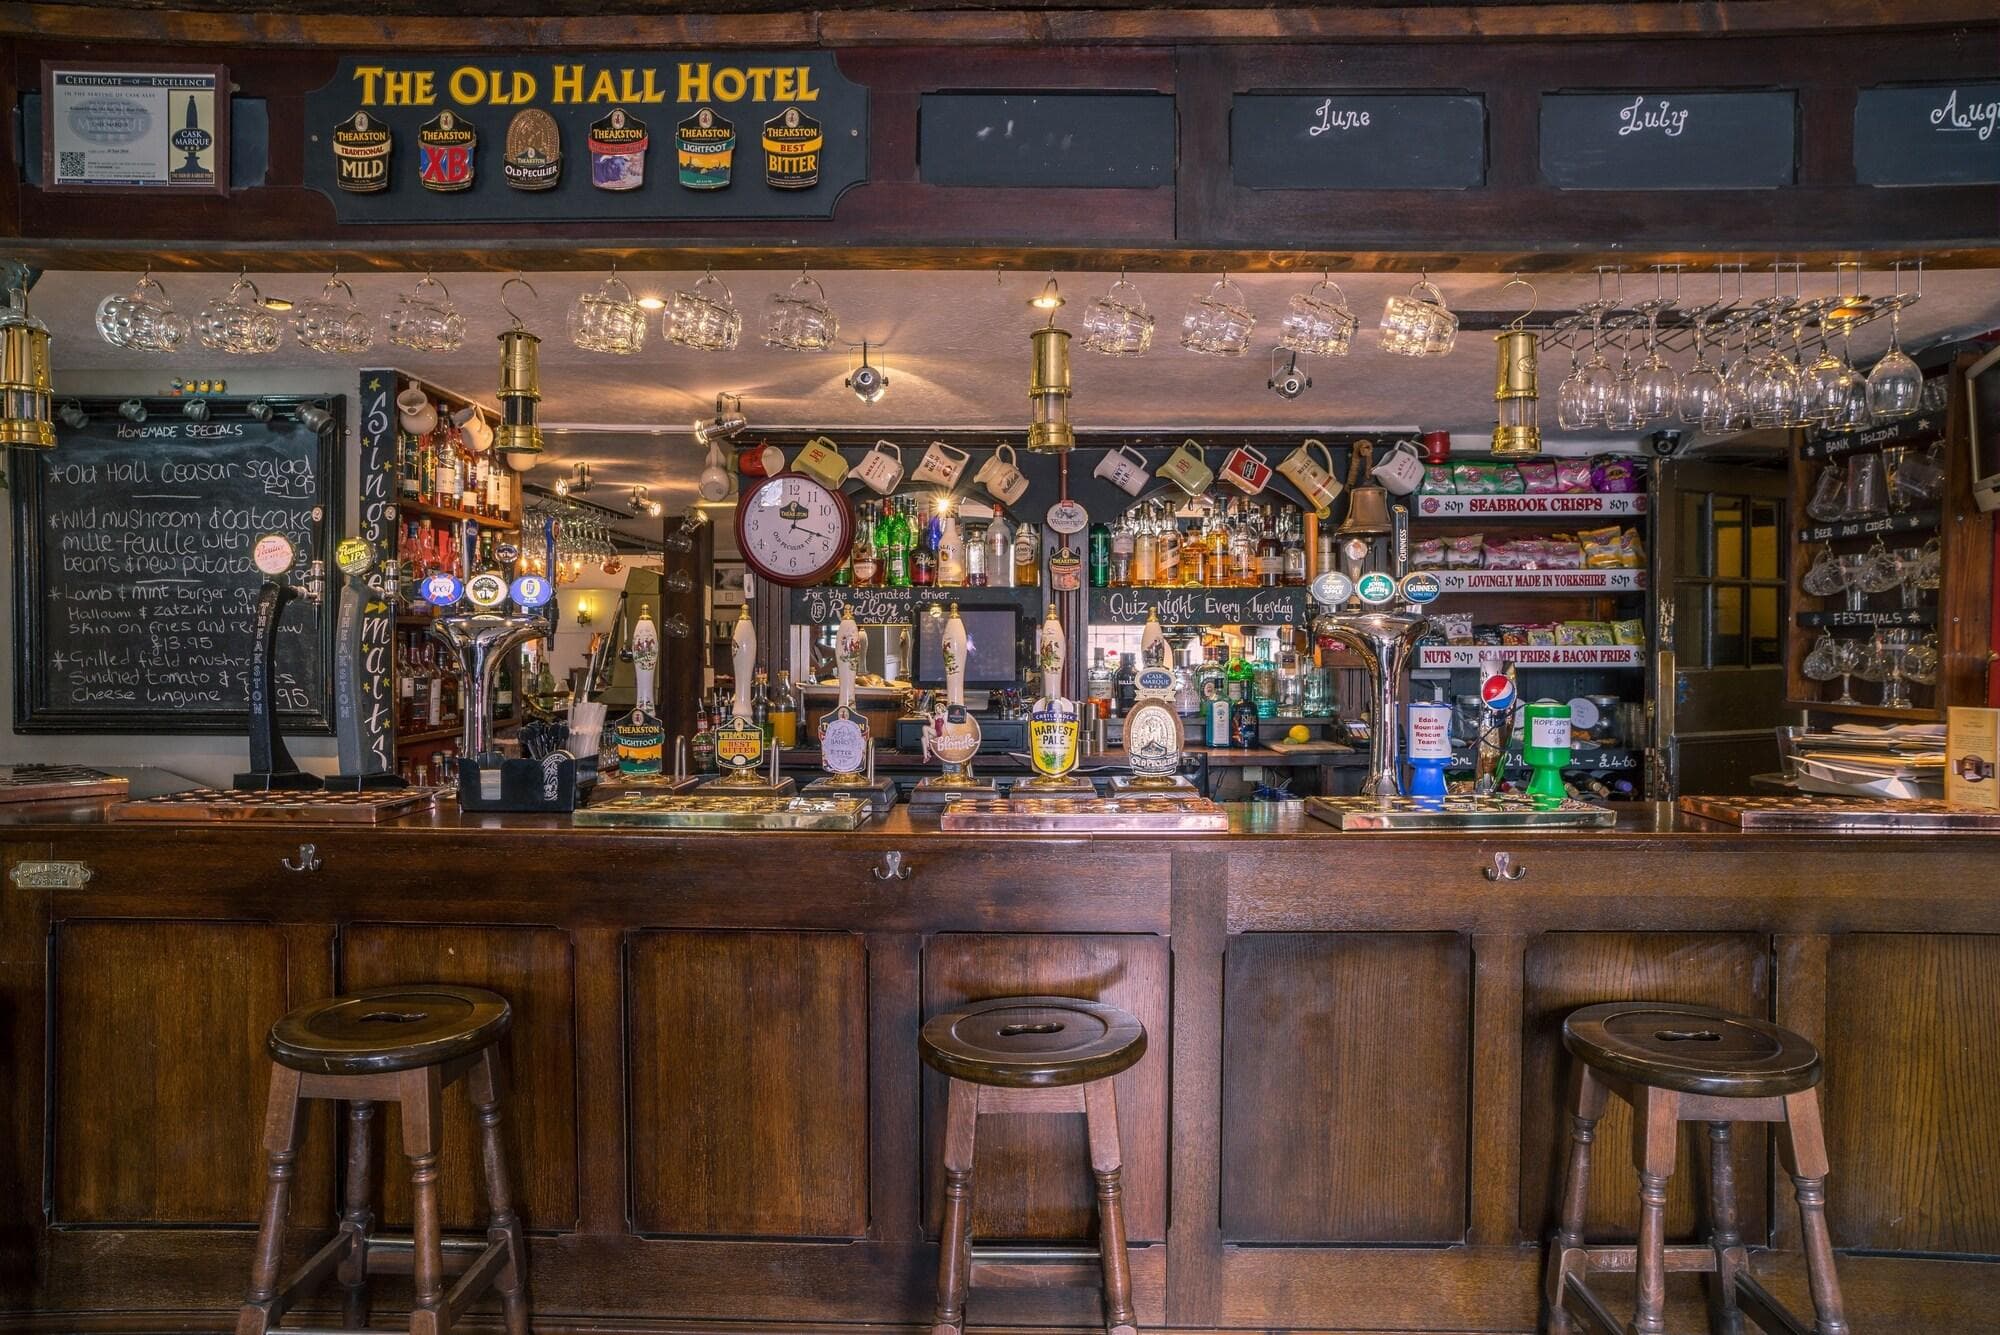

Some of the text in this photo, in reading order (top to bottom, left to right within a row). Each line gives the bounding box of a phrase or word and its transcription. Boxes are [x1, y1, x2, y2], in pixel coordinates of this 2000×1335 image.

[65, 75, 122, 85] CERTIFICATE
[151, 76, 207, 87] EXCELLENCE
[353, 62, 821, 106] THE OLD HALL HOTEL
[1309, 98, 1371, 136] June
[1618, 96, 1689, 136] July
[336, 131, 386, 141] THEAKSTON
[422, 130, 471, 141] THEAKSTON
[592, 128, 643, 140] THEAKSTON
[680, 128, 731, 138] THEAKSTON
[766, 127, 817, 138] THEAKSTON
[175, 138, 210, 146] MARQUE
[683, 143, 726, 153] LIGHTFOOT
[780, 144, 806, 153] BEST
[341, 146, 384, 156] TRADITIONAL
[342, 159, 384, 179] MILD
[423, 147, 470, 182] XB
[769, 154, 817, 174] BITTER
[504, 165, 558, 178] OLD PECULIER
[117, 422, 243, 438] HOMEMADE SPECIALS
[1825, 425, 1900, 454] BANK HOLIDAY
[107, 460, 152, 482] Hall
[789, 484, 800, 496] 12
[808, 491, 817, 503] 11
[820, 504, 832, 517] 10
[1444, 497, 1629, 513] 80p SEABROOK CRISPS 80p
[751, 519, 759, 531] 3
[828, 522, 836, 534] 9
[1813, 519, 1894, 540] BEER AND CIDER
[757, 538, 765, 550] 4
[822, 541, 829, 552] 8
[1399, 528, 1407, 562] GUINNESS
[770, 550, 778, 562] 5
[64, 554, 121, 573] beans
[136, 556, 176, 574] new
[789, 557, 797, 569] 6
[1445, 573, 1630, 589] 80p LOVINGLY MADE IN YORKSHIRE 80p
[177, 585, 228, 603] burger
[1407, 584, 1438, 593] GUINNESS
[802, 588, 823, 601] For
[827, 589, 847, 600] the
[853, 588, 912, 603] designated
[1109, 590, 1148, 621] Quiz
[1205, 597, 1240, 623] Every
[1247, 591, 1294, 622] Tuesday
[68, 606, 131, 622] Halloumi
[863, 616, 884, 625] ONLY
[1833, 611, 1903, 625] FESTIVALS
[118, 623, 142, 635] on
[150, 620, 192, 634] fries
[197, 618, 225, 633] and
[151, 634, 213, 656] £13.95
[138, 650, 180, 668] field
[1423, 651, 1451, 664] NUTS
[1454, 652, 1473, 665] 90p
[1520, 651, 1551, 663] FRIES
[1552, 651, 1561, 663] &
[1562, 650, 1599, 663] BACON
[1600, 650, 1631, 663] FRIES
[68, 668, 140, 686] Sundried
[145, 669, 210, 686] tomato
[72, 687, 136, 702] Cheese
[361, 616, 391, 772] malts
[618, 725, 660, 736] THEAKSTON
[1034, 725, 1075, 737] HARVEST
[621, 738, 657, 747] LIGHTFOOT
[727, 740, 752, 748] BEST
[1042, 735, 1065, 746] PALE
[1598, 752, 1637, 768] £4.60
